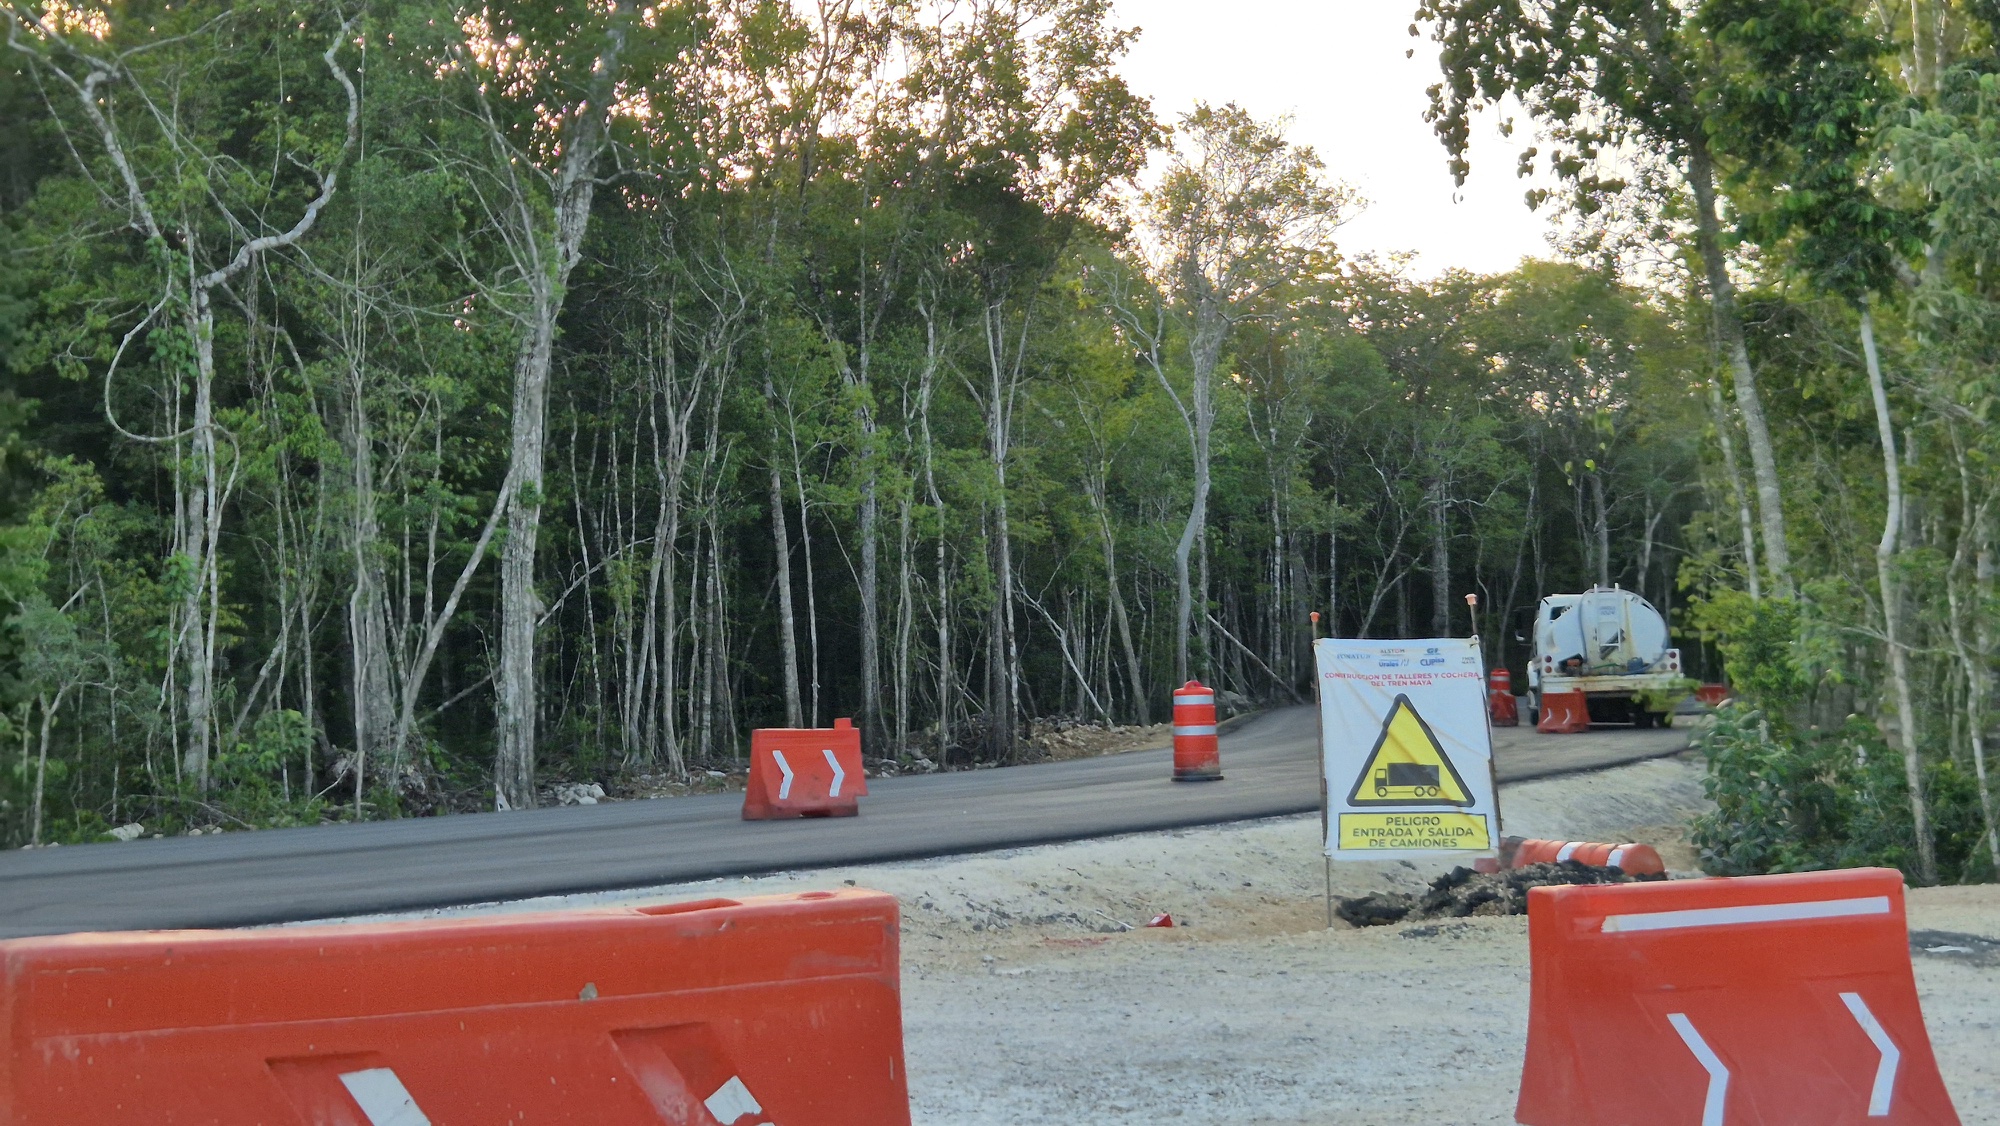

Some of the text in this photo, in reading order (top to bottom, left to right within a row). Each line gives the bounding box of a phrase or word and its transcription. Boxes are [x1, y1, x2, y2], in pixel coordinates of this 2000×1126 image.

[1385, 816, 1441, 826] PELIGRO
[1352, 826, 1474, 837] ENTRADA Y SALIDA
[1369, 838, 1458, 848] DE CAMIONES
